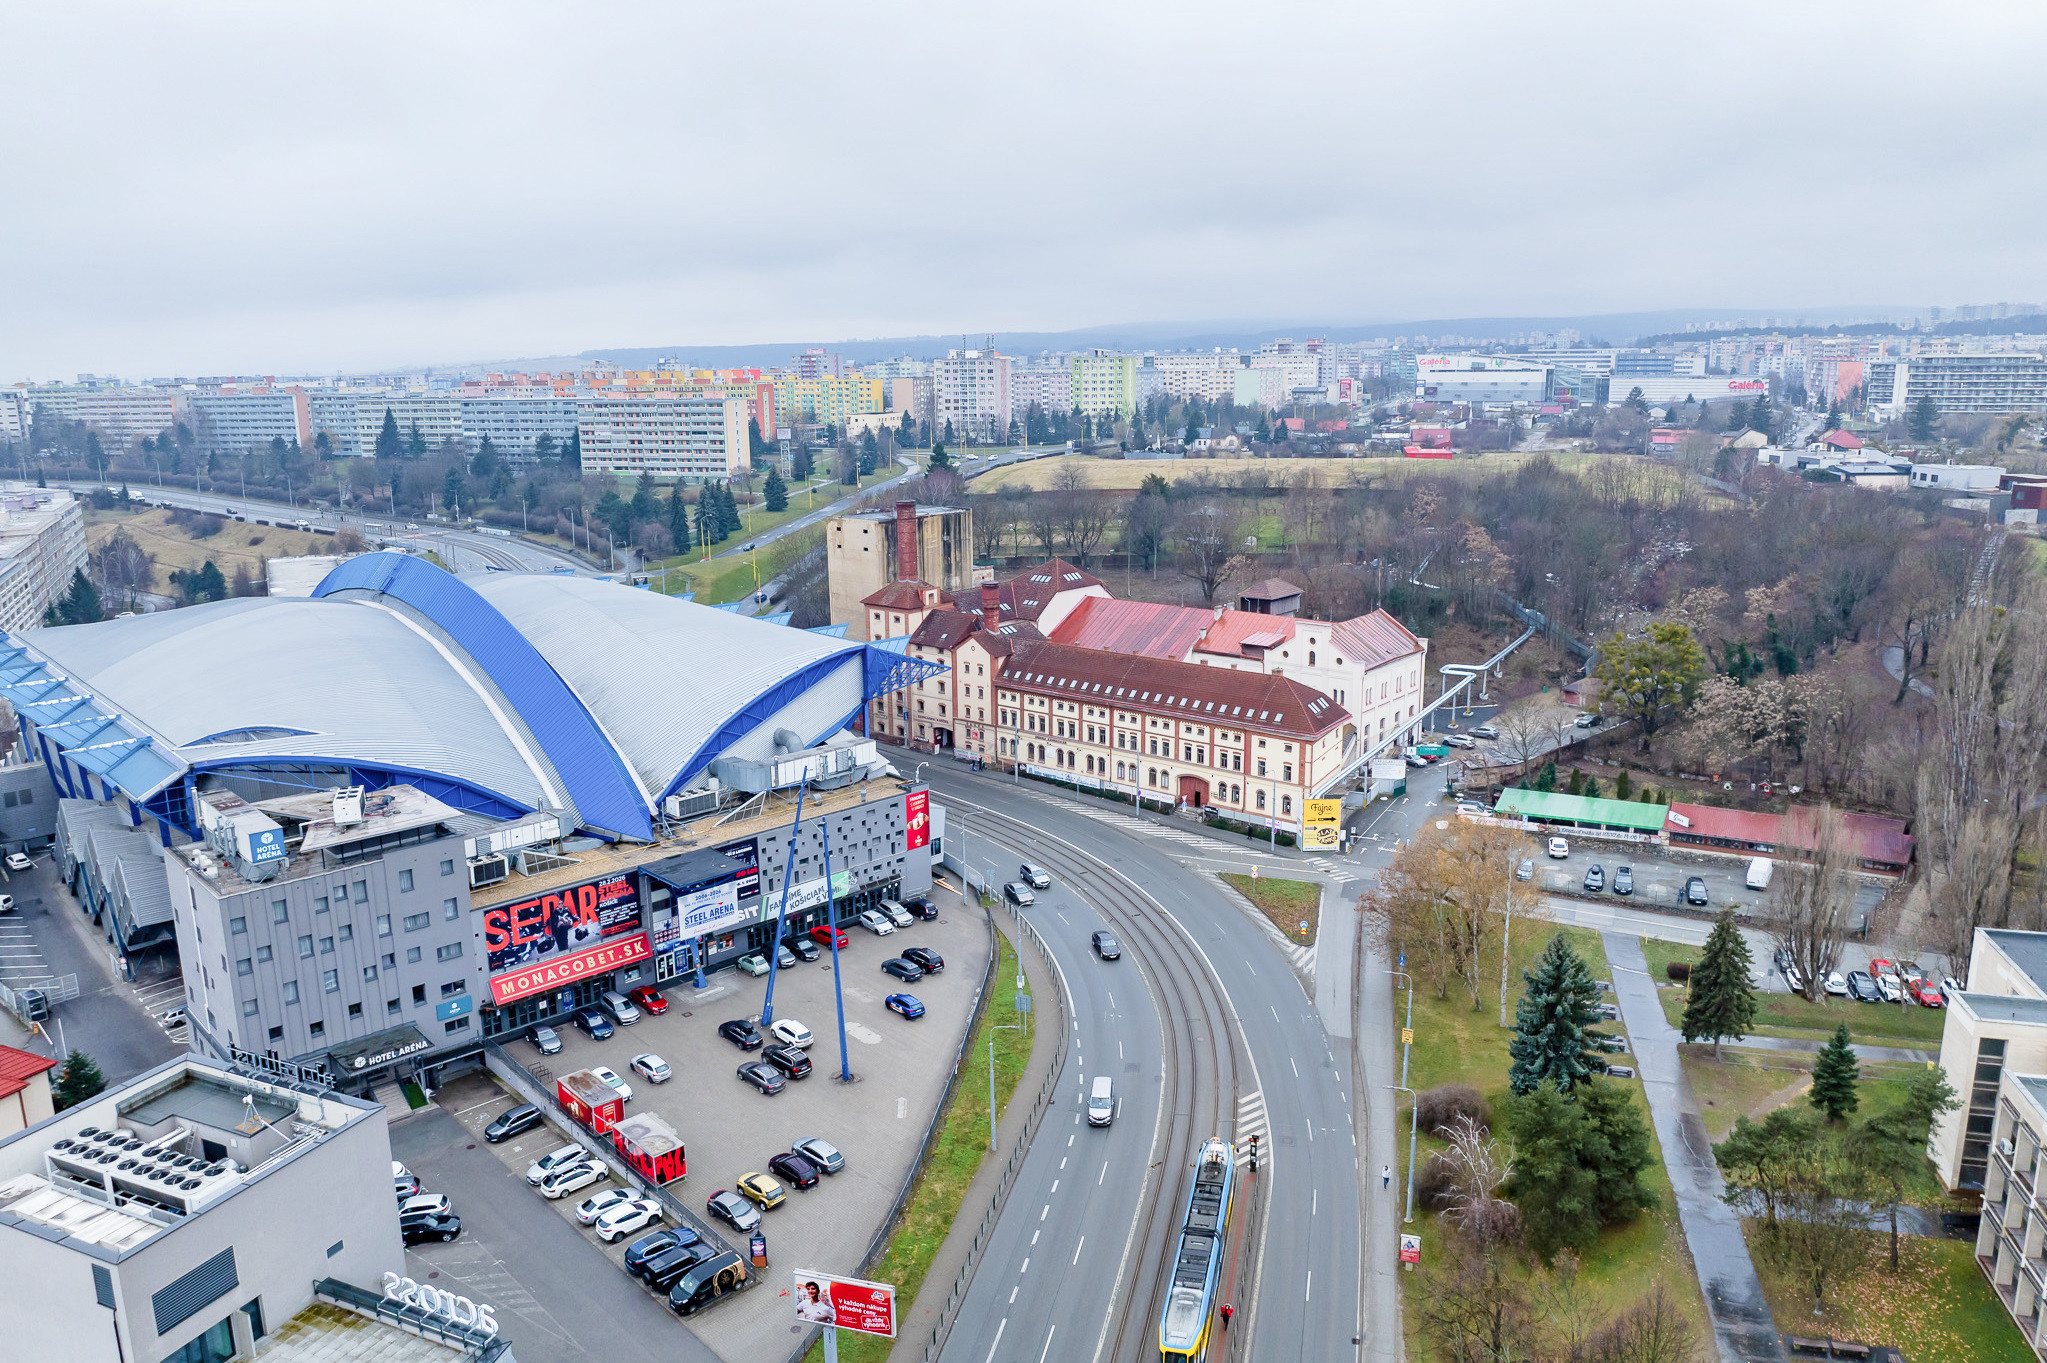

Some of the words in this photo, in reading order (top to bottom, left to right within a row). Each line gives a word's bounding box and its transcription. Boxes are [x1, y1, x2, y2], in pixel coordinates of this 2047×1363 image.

[1728, 380, 1765, 389] Galéria
[257, 843, 280, 853] HOTEL
[598, 880, 629, 895] STEEL
[599, 875, 626, 886] 28.2.2026
[599, 886, 635, 903] ARENA
[684, 911, 707, 925] STEEL
[709, 903, 734, 918] ARENA
[501, 941, 644, 995] MONACOBET.SK
[369, 1050, 397, 1066] HOTEL
[399, 1040, 428, 1056] ARÉNA
[838, 1305, 862, 1313] výhodné
[843, 1299, 865, 1308] každom
[866, 1303, 887, 1312] nákupe
